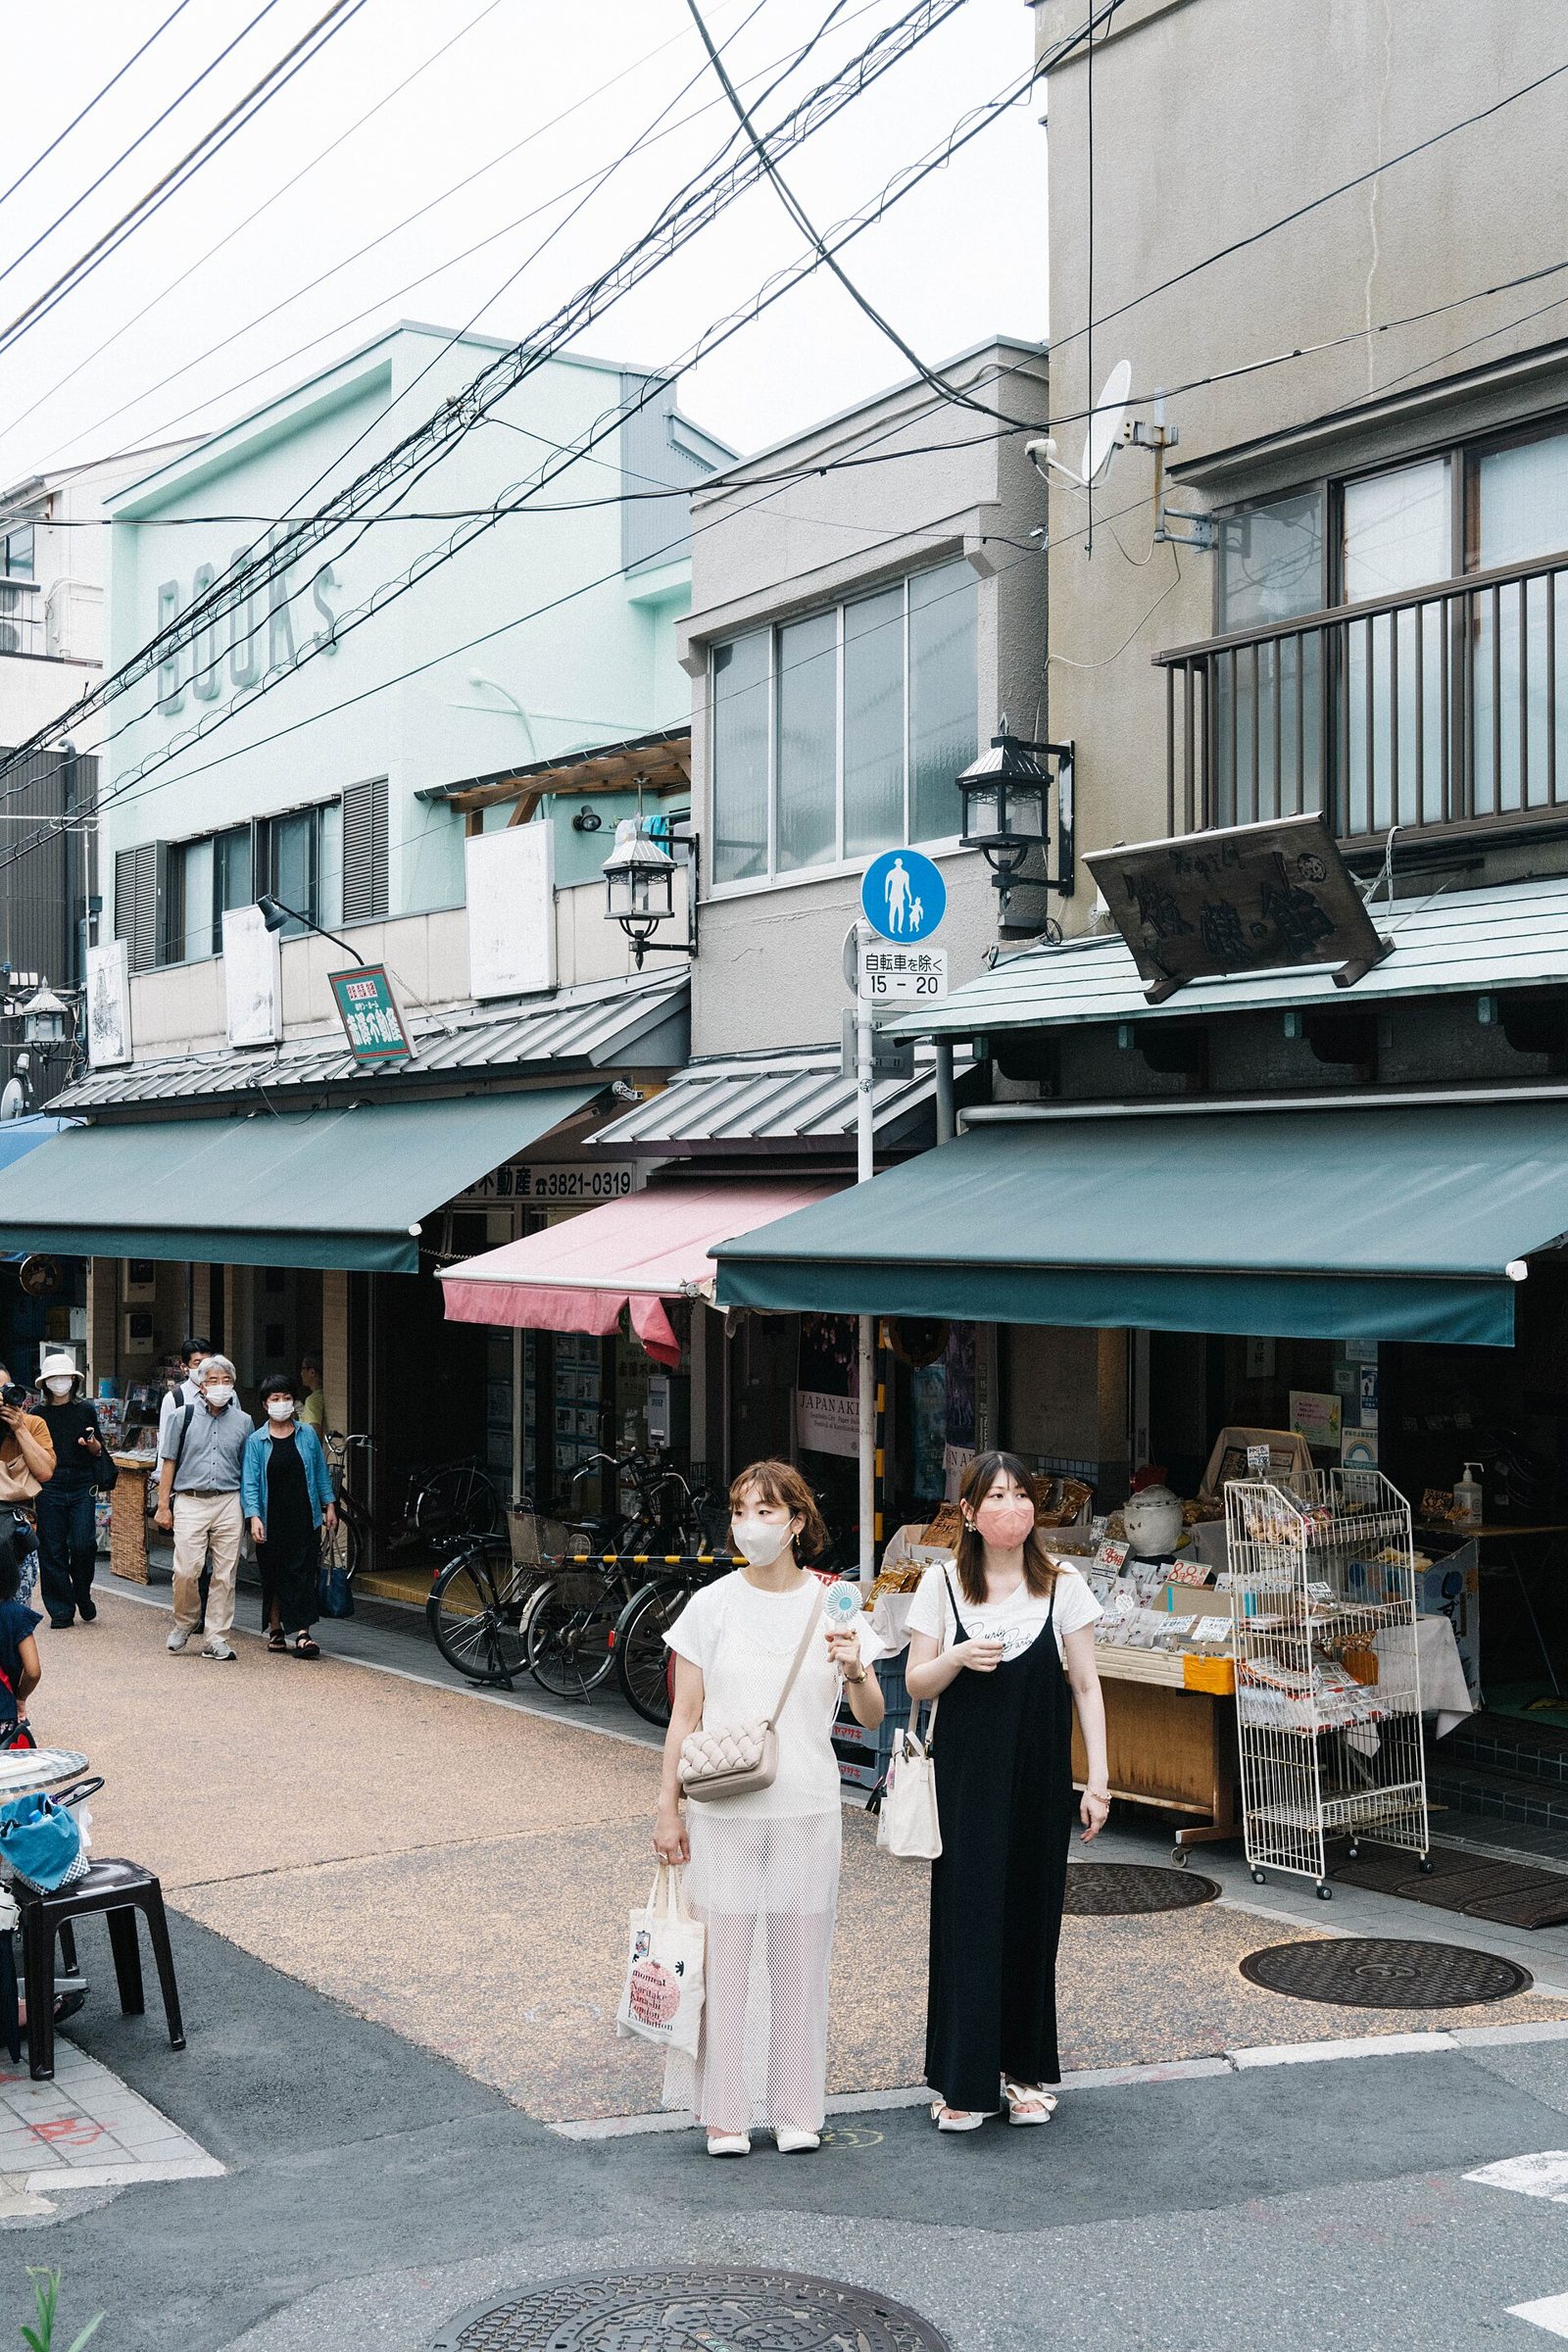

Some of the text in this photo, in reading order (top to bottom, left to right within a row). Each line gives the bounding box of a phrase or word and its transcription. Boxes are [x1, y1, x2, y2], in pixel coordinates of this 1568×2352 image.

[158, 520, 335, 716] BOOKS
[865, 953, 943, 972] 自転車を除く
[871, 975, 887, 993] 15
[916, 976, 938, 994] 20
[465, 1167, 631, 1196] 不動産 3821-0319
[800, 1395, 835, 1412] JAPAN
[834, 1725, 861, 1740] ヤマサキ
[627, 2011, 673, 2032] Exhibition
